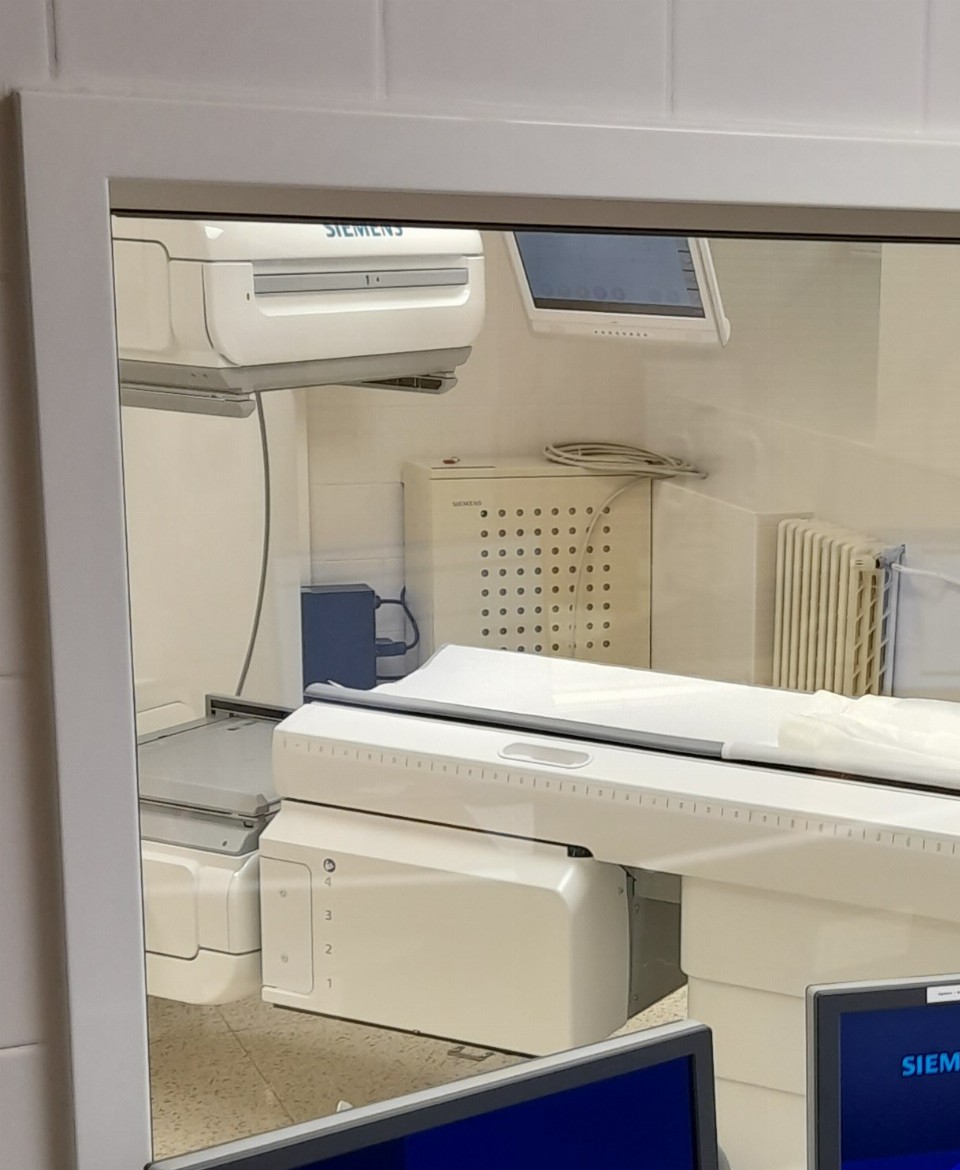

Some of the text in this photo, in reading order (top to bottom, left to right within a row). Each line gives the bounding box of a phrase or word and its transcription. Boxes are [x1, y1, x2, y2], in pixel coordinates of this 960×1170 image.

[325, 877, 332, 887] 4
[325, 910, 332, 920] 3
[325, 944, 332, 954] 2
[327, 979, 332, 988] 1
